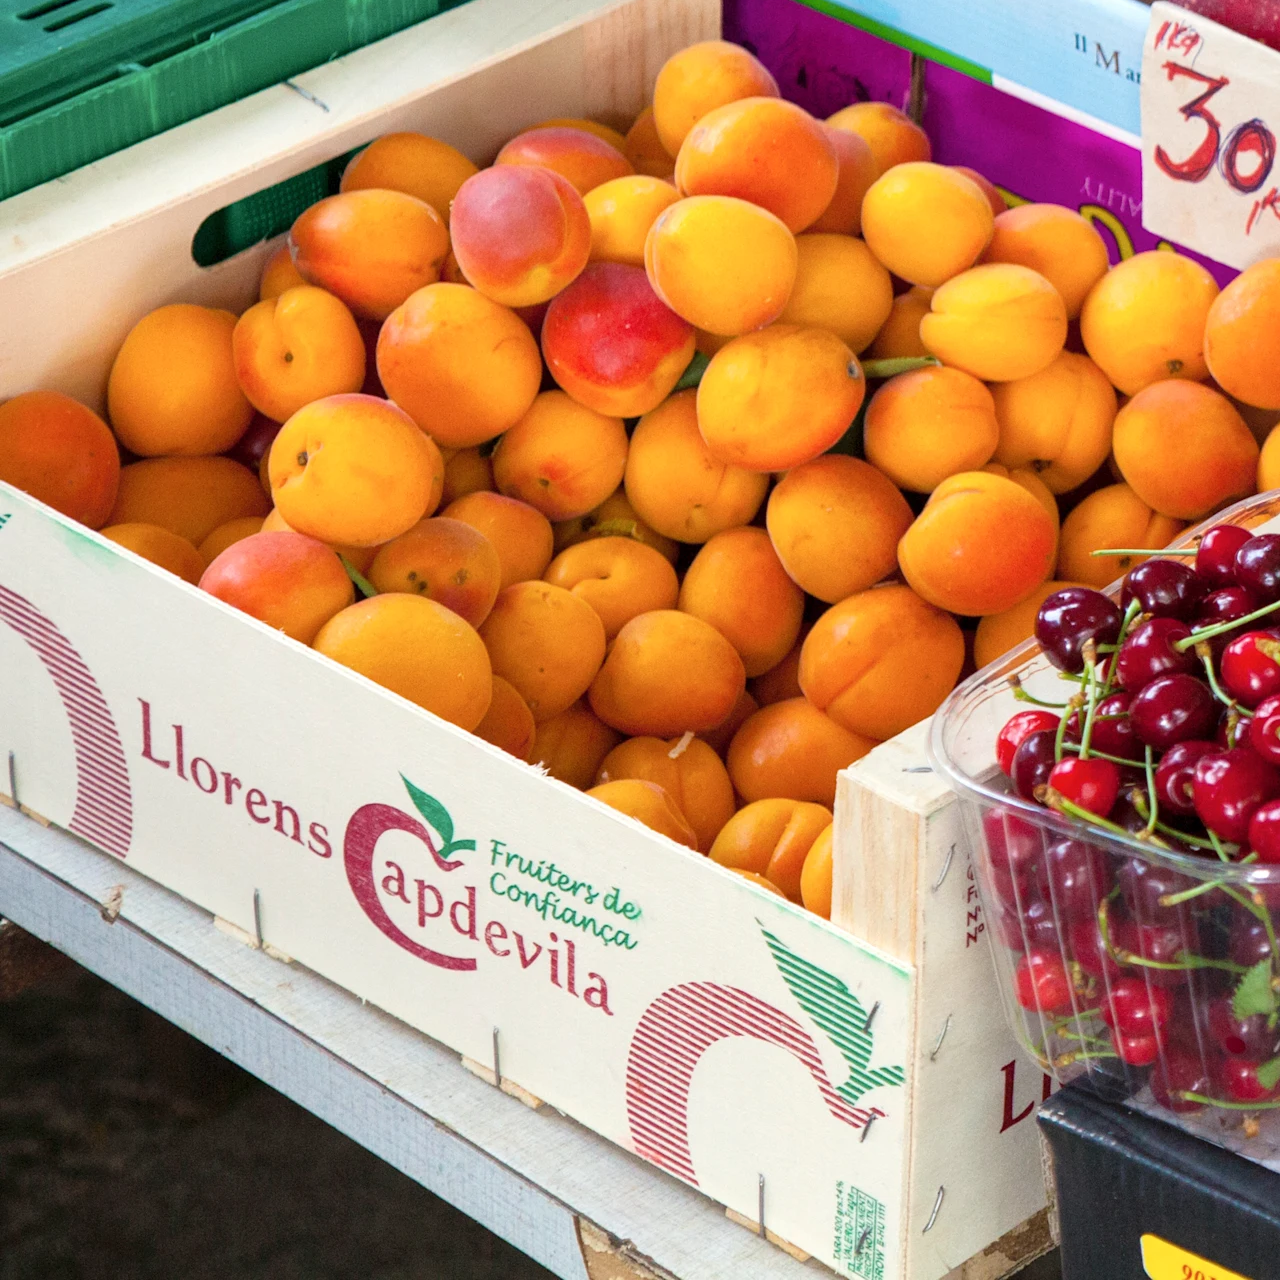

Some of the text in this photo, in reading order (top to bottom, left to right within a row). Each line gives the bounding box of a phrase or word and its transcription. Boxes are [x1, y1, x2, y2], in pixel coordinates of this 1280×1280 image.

[1154, 60, 1277, 195] 30
[137, 697, 333, 859] Llorens
[344, 803, 614, 1016] Capdevila
[490, 839, 642, 920] Fruiters de
[490, 872, 639, 950] Confiança
[833, 1235, 842, 1261] TARA
